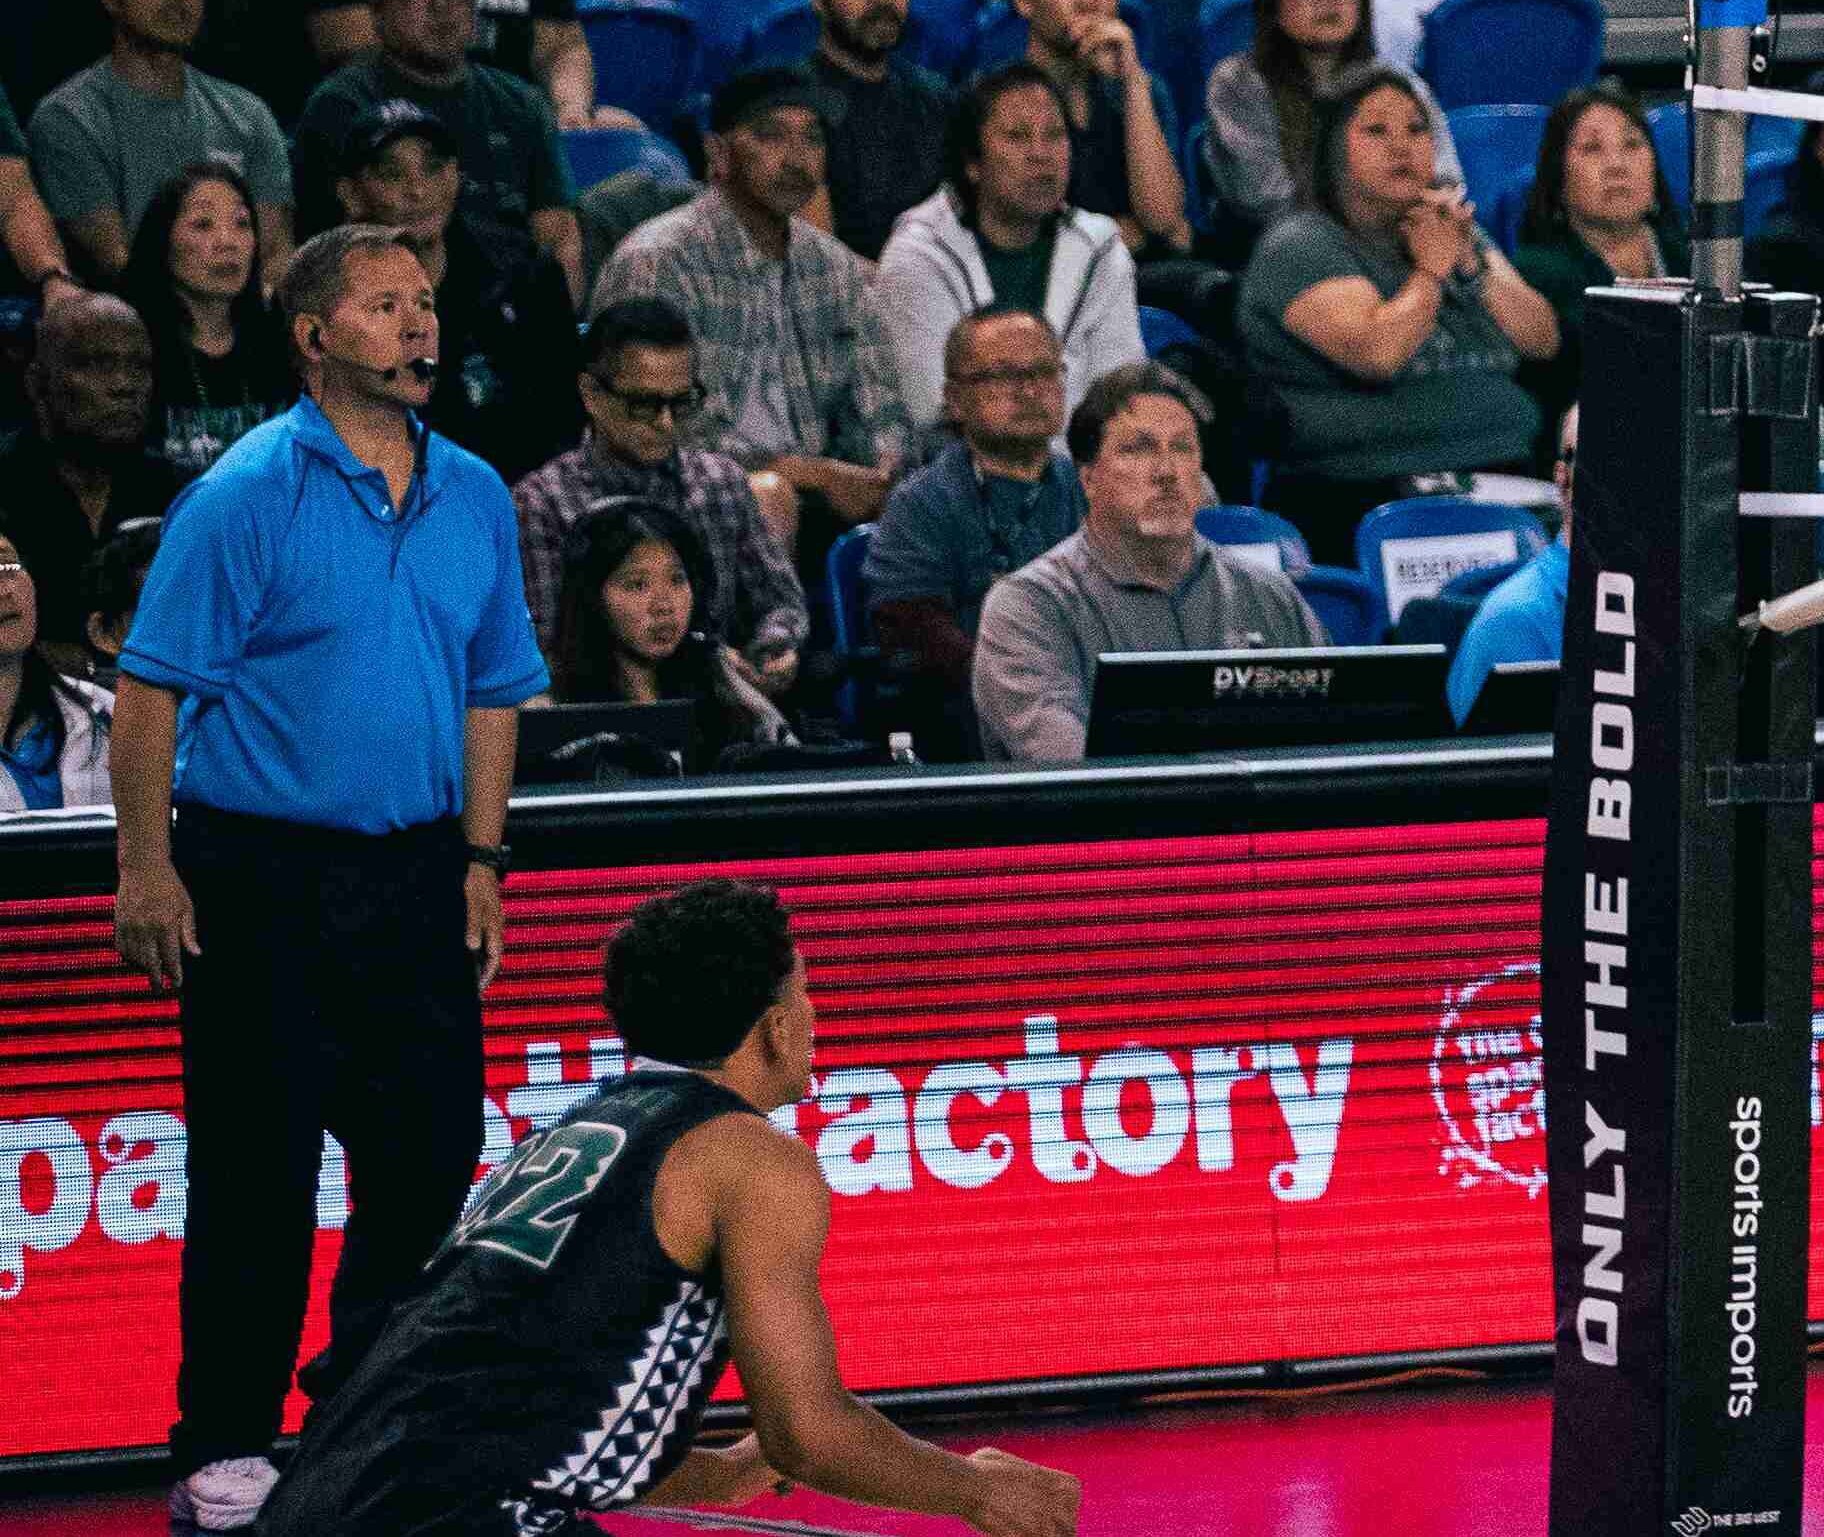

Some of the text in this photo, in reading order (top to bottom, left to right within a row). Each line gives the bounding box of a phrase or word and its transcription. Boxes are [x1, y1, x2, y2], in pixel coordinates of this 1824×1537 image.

[1577, 570, 1637, 1366] ONLY THE BOLD
[1728, 1096, 1764, 1237] sports
